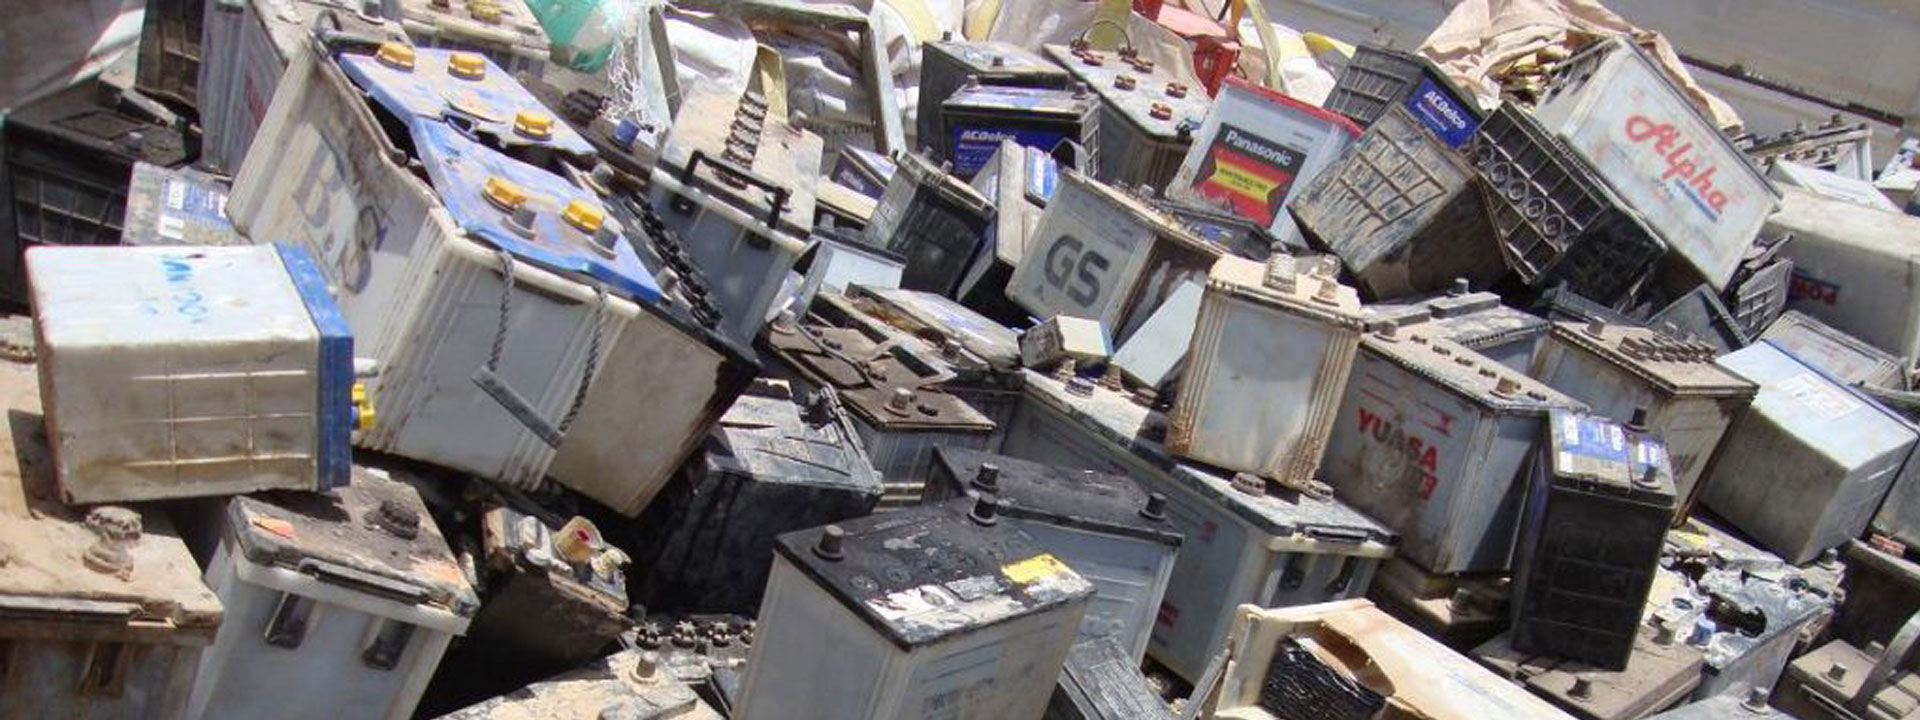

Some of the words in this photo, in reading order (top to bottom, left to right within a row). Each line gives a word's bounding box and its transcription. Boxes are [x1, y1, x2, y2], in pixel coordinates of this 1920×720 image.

[1225, 130, 1293, 166] Panasonic
[1625, 115, 1728, 214] Alpha
[1044, 233, 1110, 308] GS
[1356, 405, 1440, 475] YUASA
